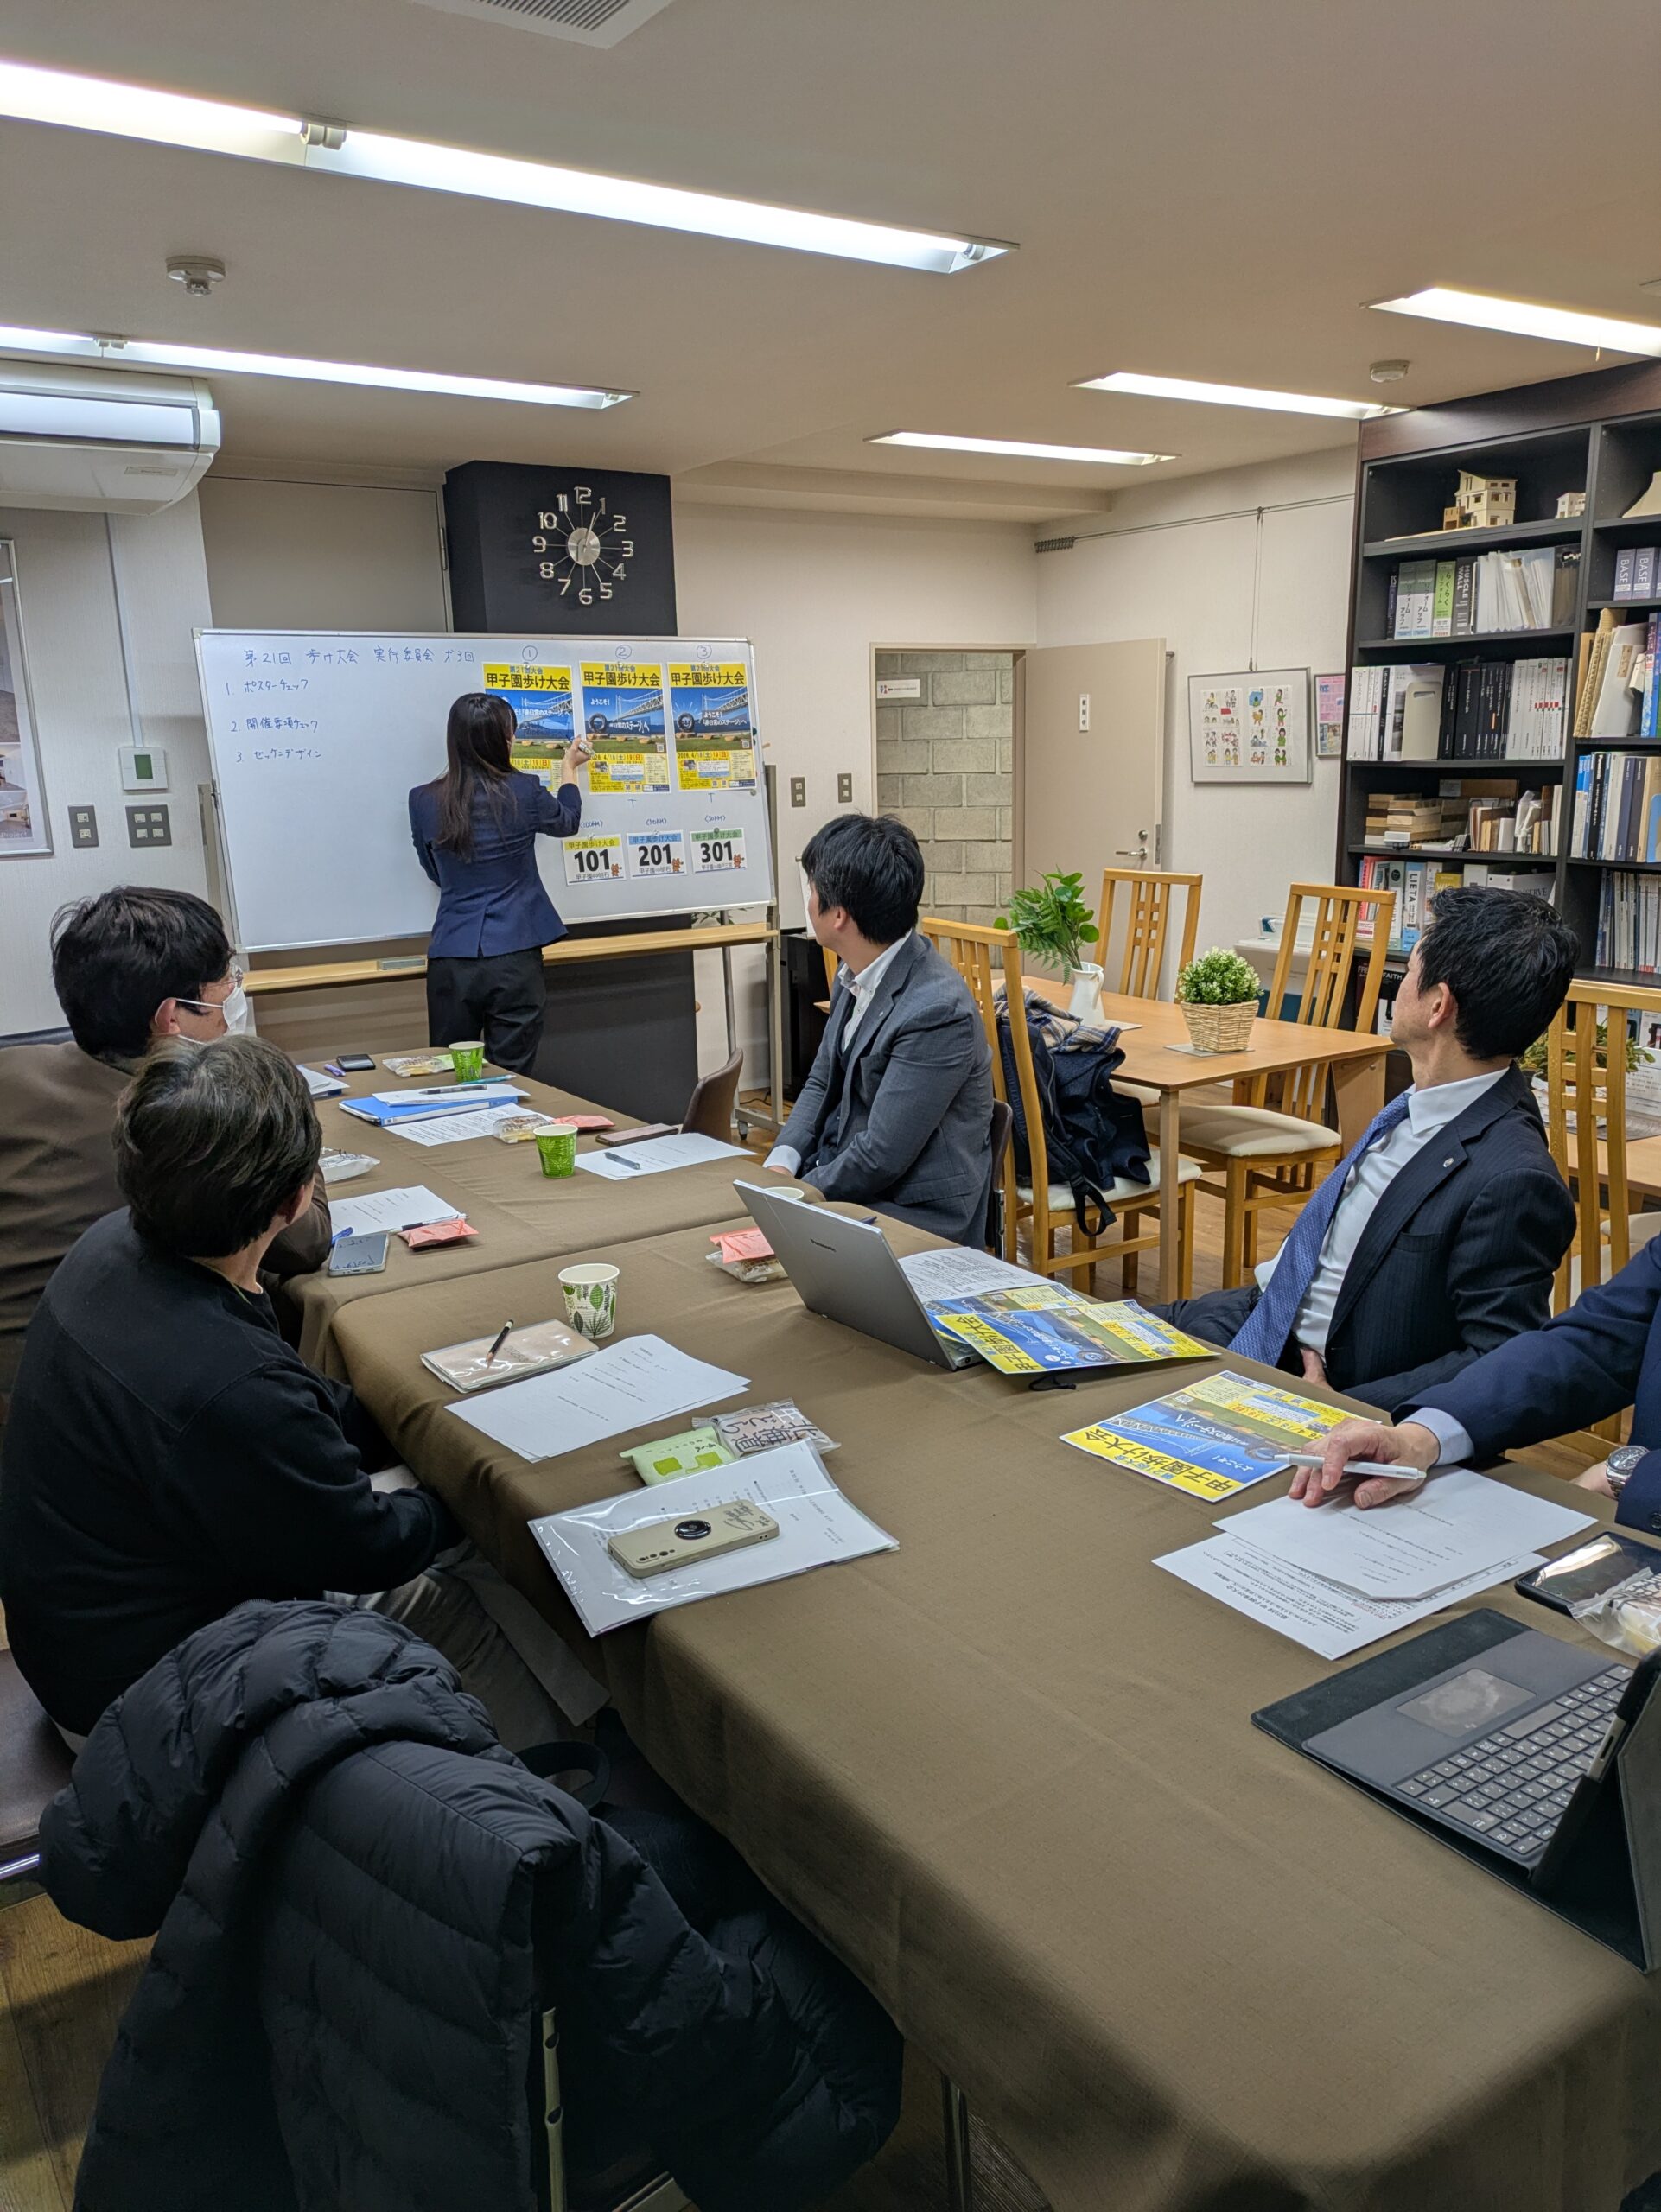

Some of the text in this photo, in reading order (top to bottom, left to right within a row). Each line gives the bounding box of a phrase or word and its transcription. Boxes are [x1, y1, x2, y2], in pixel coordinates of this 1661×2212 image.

[556, 493, 568, 512] 11
[574, 486, 592, 504] 12
[600, 498, 606, 515] 1
[538, 512, 557, 530] 10
[613, 515, 627, 531] 2
[532, 536, 547, 553] 9
[622, 541, 634, 557] 3
[539, 562, 555, 579] 8
[612, 563, 627, 580] 4
[1619, 559, 1630, 584] BASE
[1638, 557, 1649, 582] BASE
[557, 579, 571, 595] 7
[600, 582, 613, 599] 5
[1462, 565, 1471, 599] MUSCLE
[578, 588, 593, 605] 6
[373, 645, 435, 664] 実行委員会
[244, 679, 309, 693] ポスターチェック
[487, 672, 570, 690] 甲子園歩け大会
[583, 671, 660, 687] 甲子園歩け大会
[671, 671, 745, 686] 甲子園歩け大会
[632, 834, 678, 844] 甲子園歩け大会
[695, 830, 738, 840] 甲子園歩け大会
[568, 839, 616, 849] 甲子園歩け大会
[700, 840, 733, 863] 301
[574, 849, 610, 873] 101
[638, 844, 671, 867] 201
[1409, 874, 1418, 903] LIETA
[1382, 971, 1403, 980] FAITH
[956, 1316, 1039, 1370] 甲子園歩け大会
[722, 1408, 803, 1434] 生どら
[735, 1419, 819, 1453] 北海道
[1085, 1428, 1233, 1492] 甲子園歩け大会
